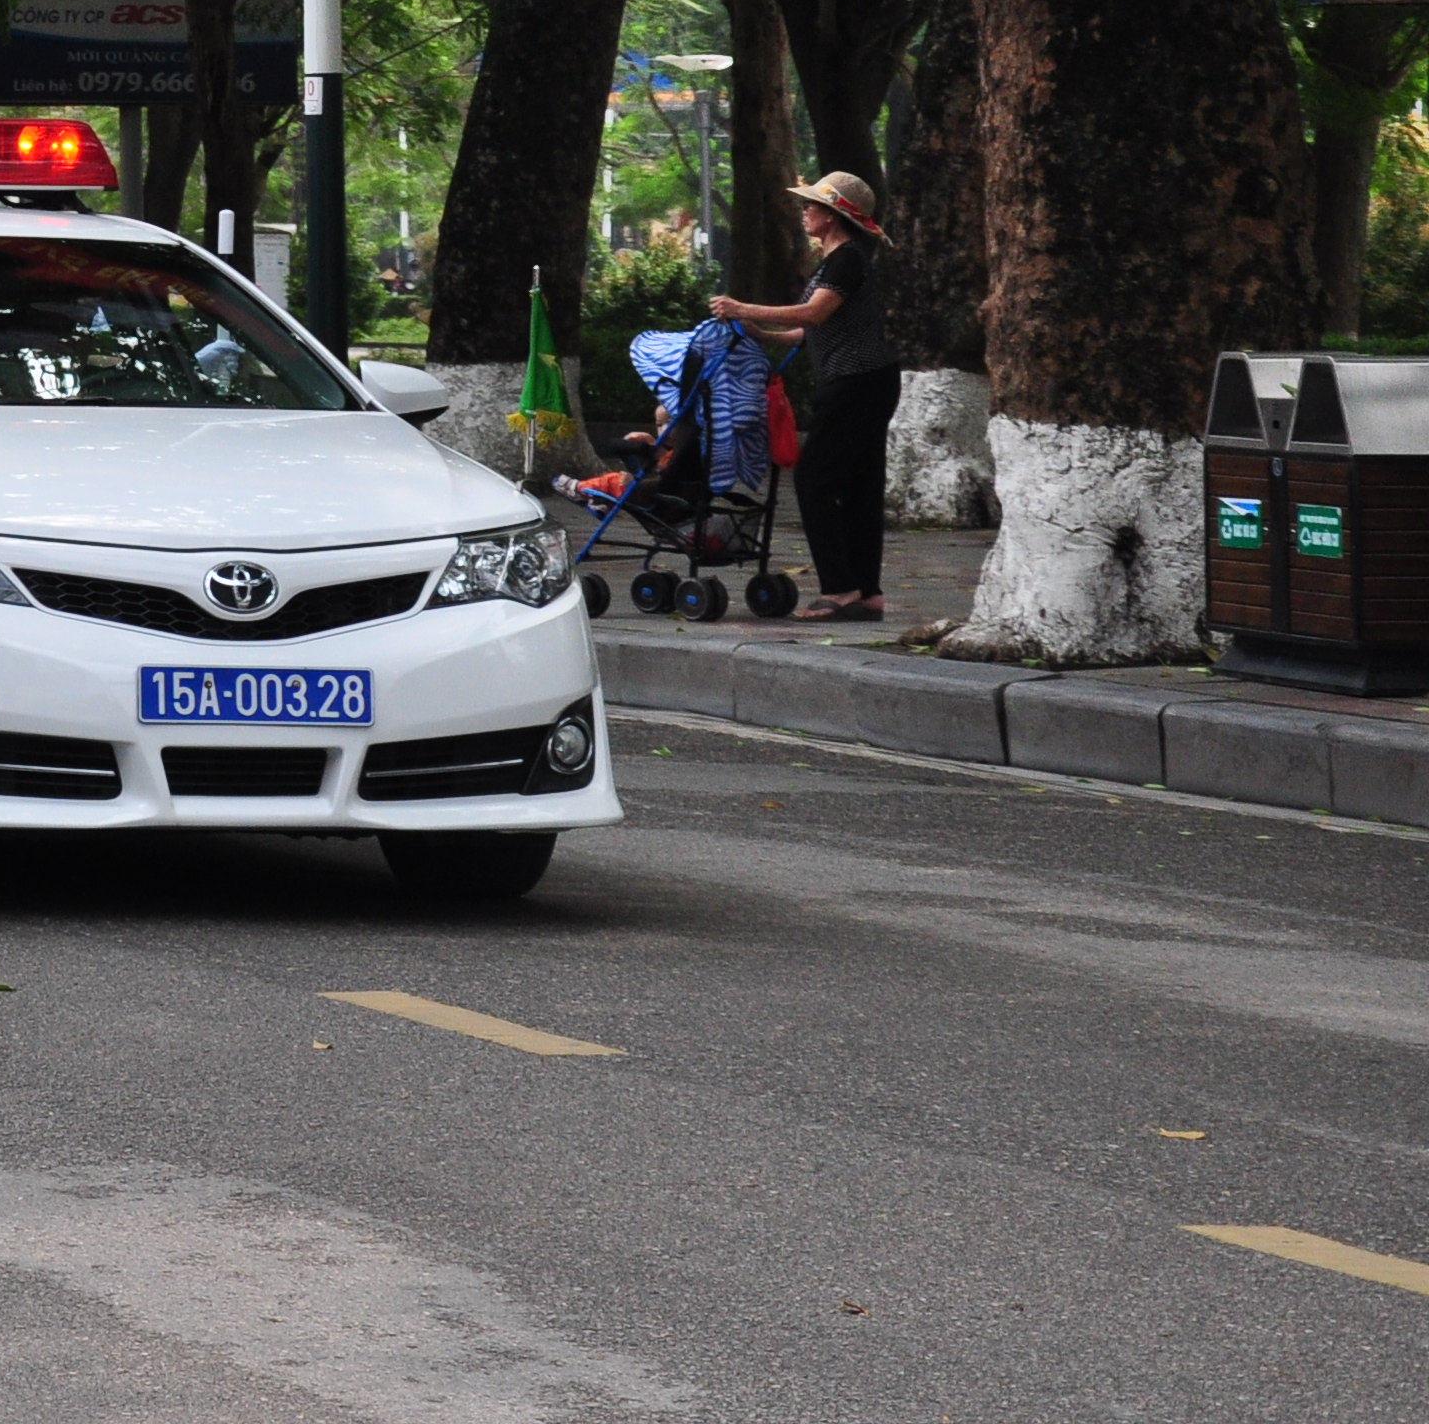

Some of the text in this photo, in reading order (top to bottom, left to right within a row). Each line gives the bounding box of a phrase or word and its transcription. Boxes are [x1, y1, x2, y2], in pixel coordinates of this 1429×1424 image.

[12, 7, 60, 24] CÔNG
[63, 10, 81, 24] TY
[84, 10, 105, 24] CP
[152, 671, 366, 719] 15A-003.28
